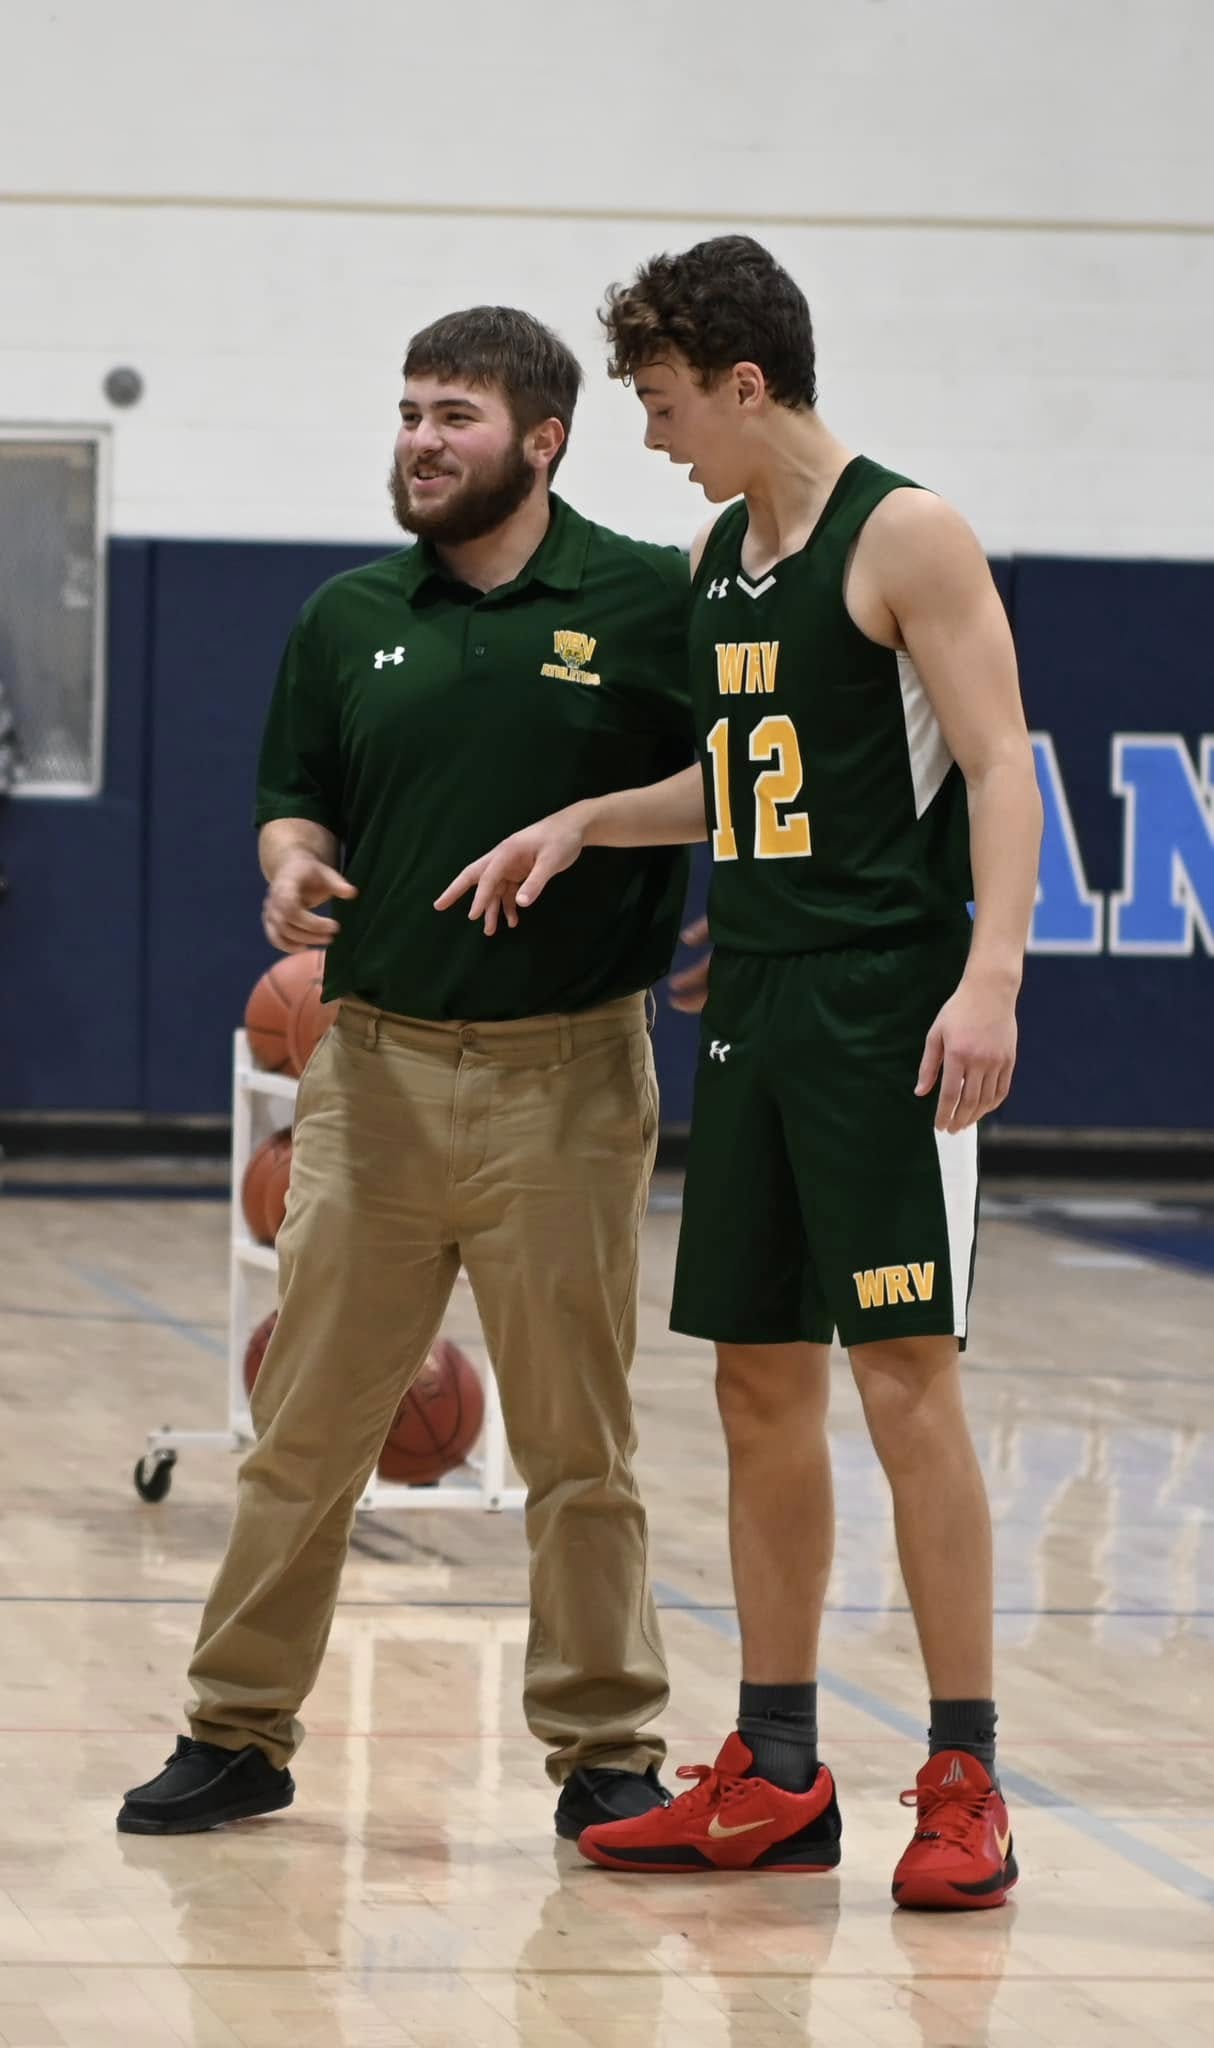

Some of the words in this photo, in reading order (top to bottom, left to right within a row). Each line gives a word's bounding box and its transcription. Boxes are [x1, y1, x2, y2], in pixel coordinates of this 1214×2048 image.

[715, 641, 779, 694] WRV
[706, 714, 812, 862] 12
[852, 1261, 935, 1309] WRV
